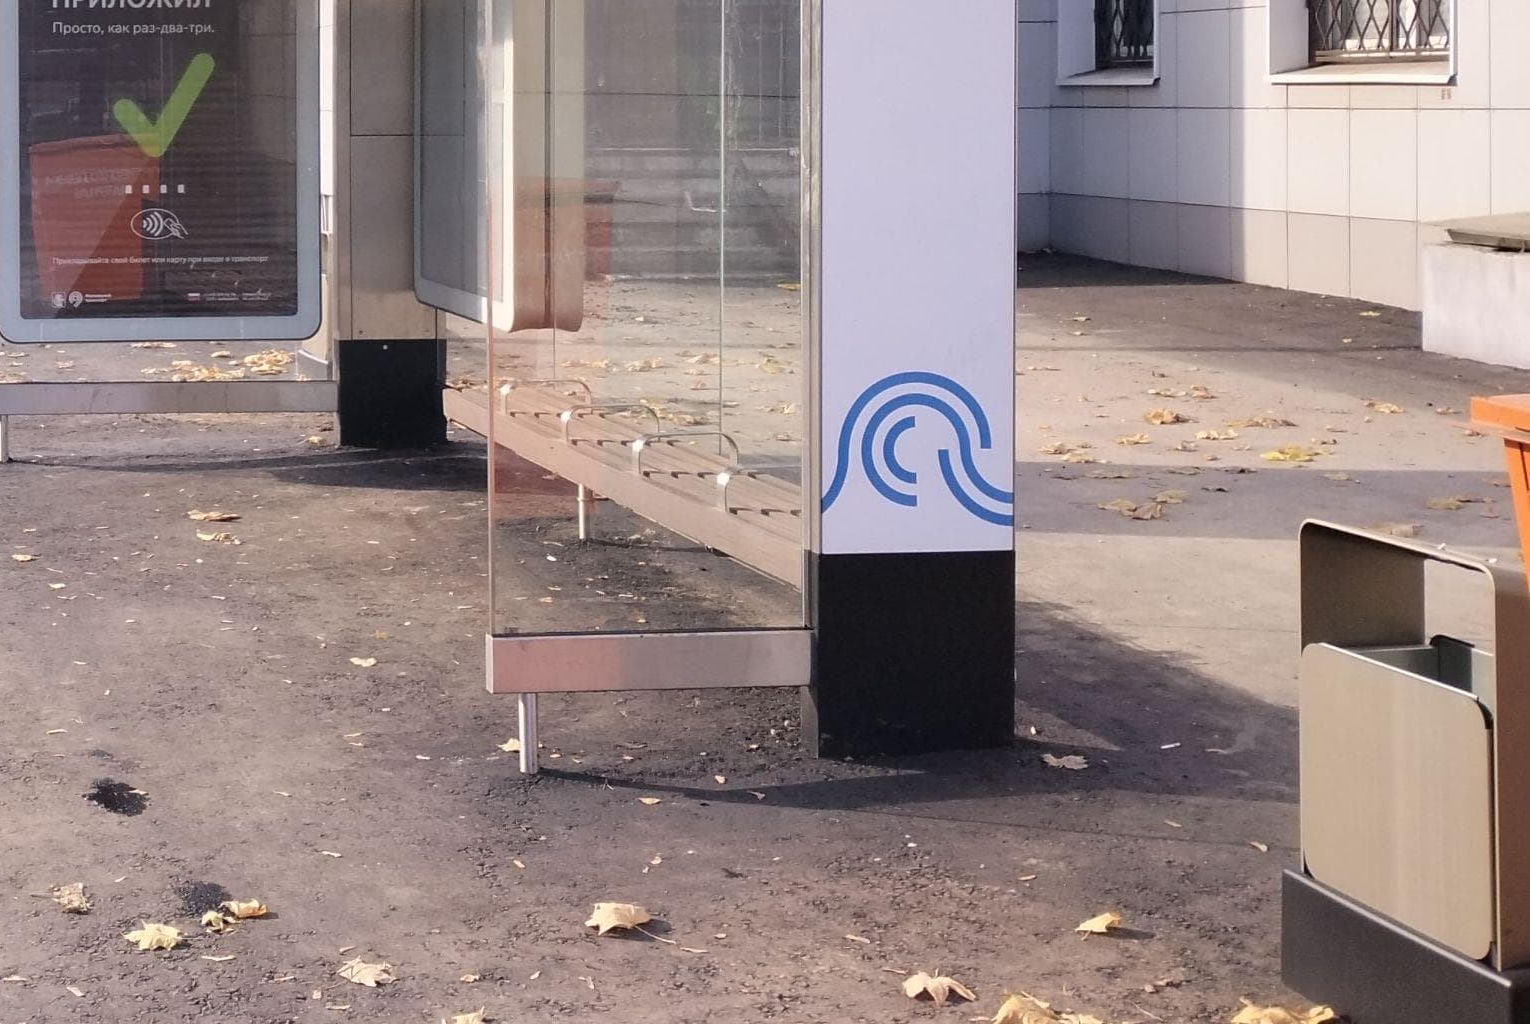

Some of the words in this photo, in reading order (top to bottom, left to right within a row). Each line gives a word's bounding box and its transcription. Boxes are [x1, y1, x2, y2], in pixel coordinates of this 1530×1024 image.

[52, 21, 105, 36] Просто,
[108, 24, 130, 34] как
[133, 24, 215, 36] раз-два-три.
